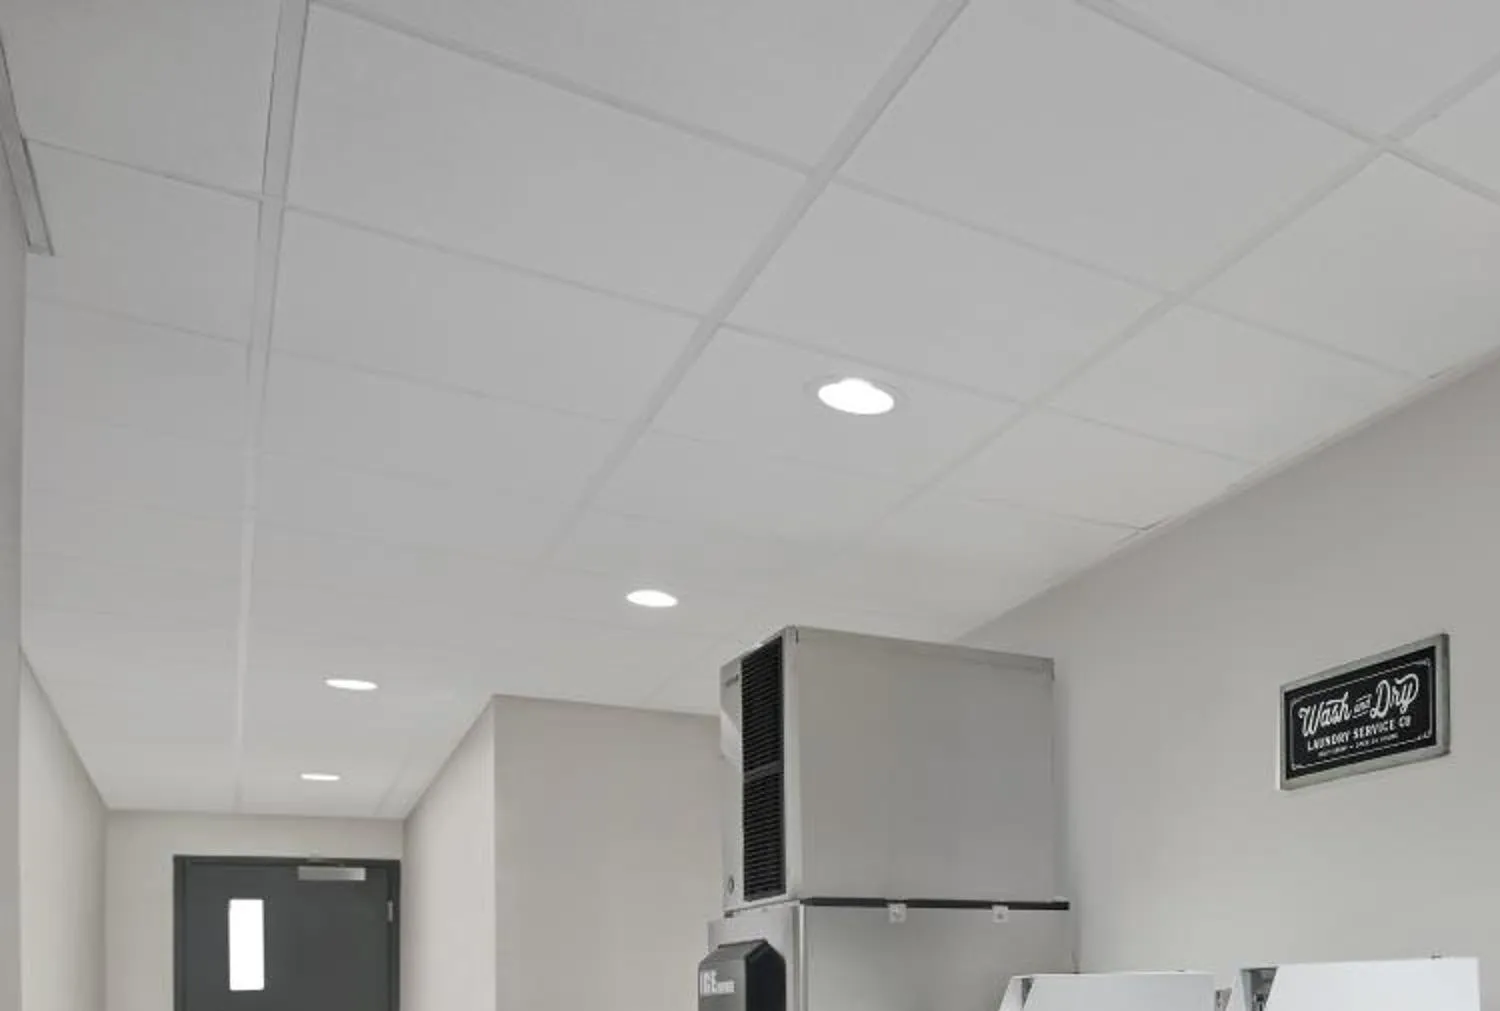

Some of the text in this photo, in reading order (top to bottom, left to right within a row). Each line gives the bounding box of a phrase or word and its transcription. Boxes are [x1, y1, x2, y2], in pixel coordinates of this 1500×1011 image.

[1298, 691, 1352, 737] Wash
[1369, 673, 1419, 719] Dry
[1307, 730, 1351, 751] LAUNDRY
[1352, 719, 1396, 740] SERVICE
